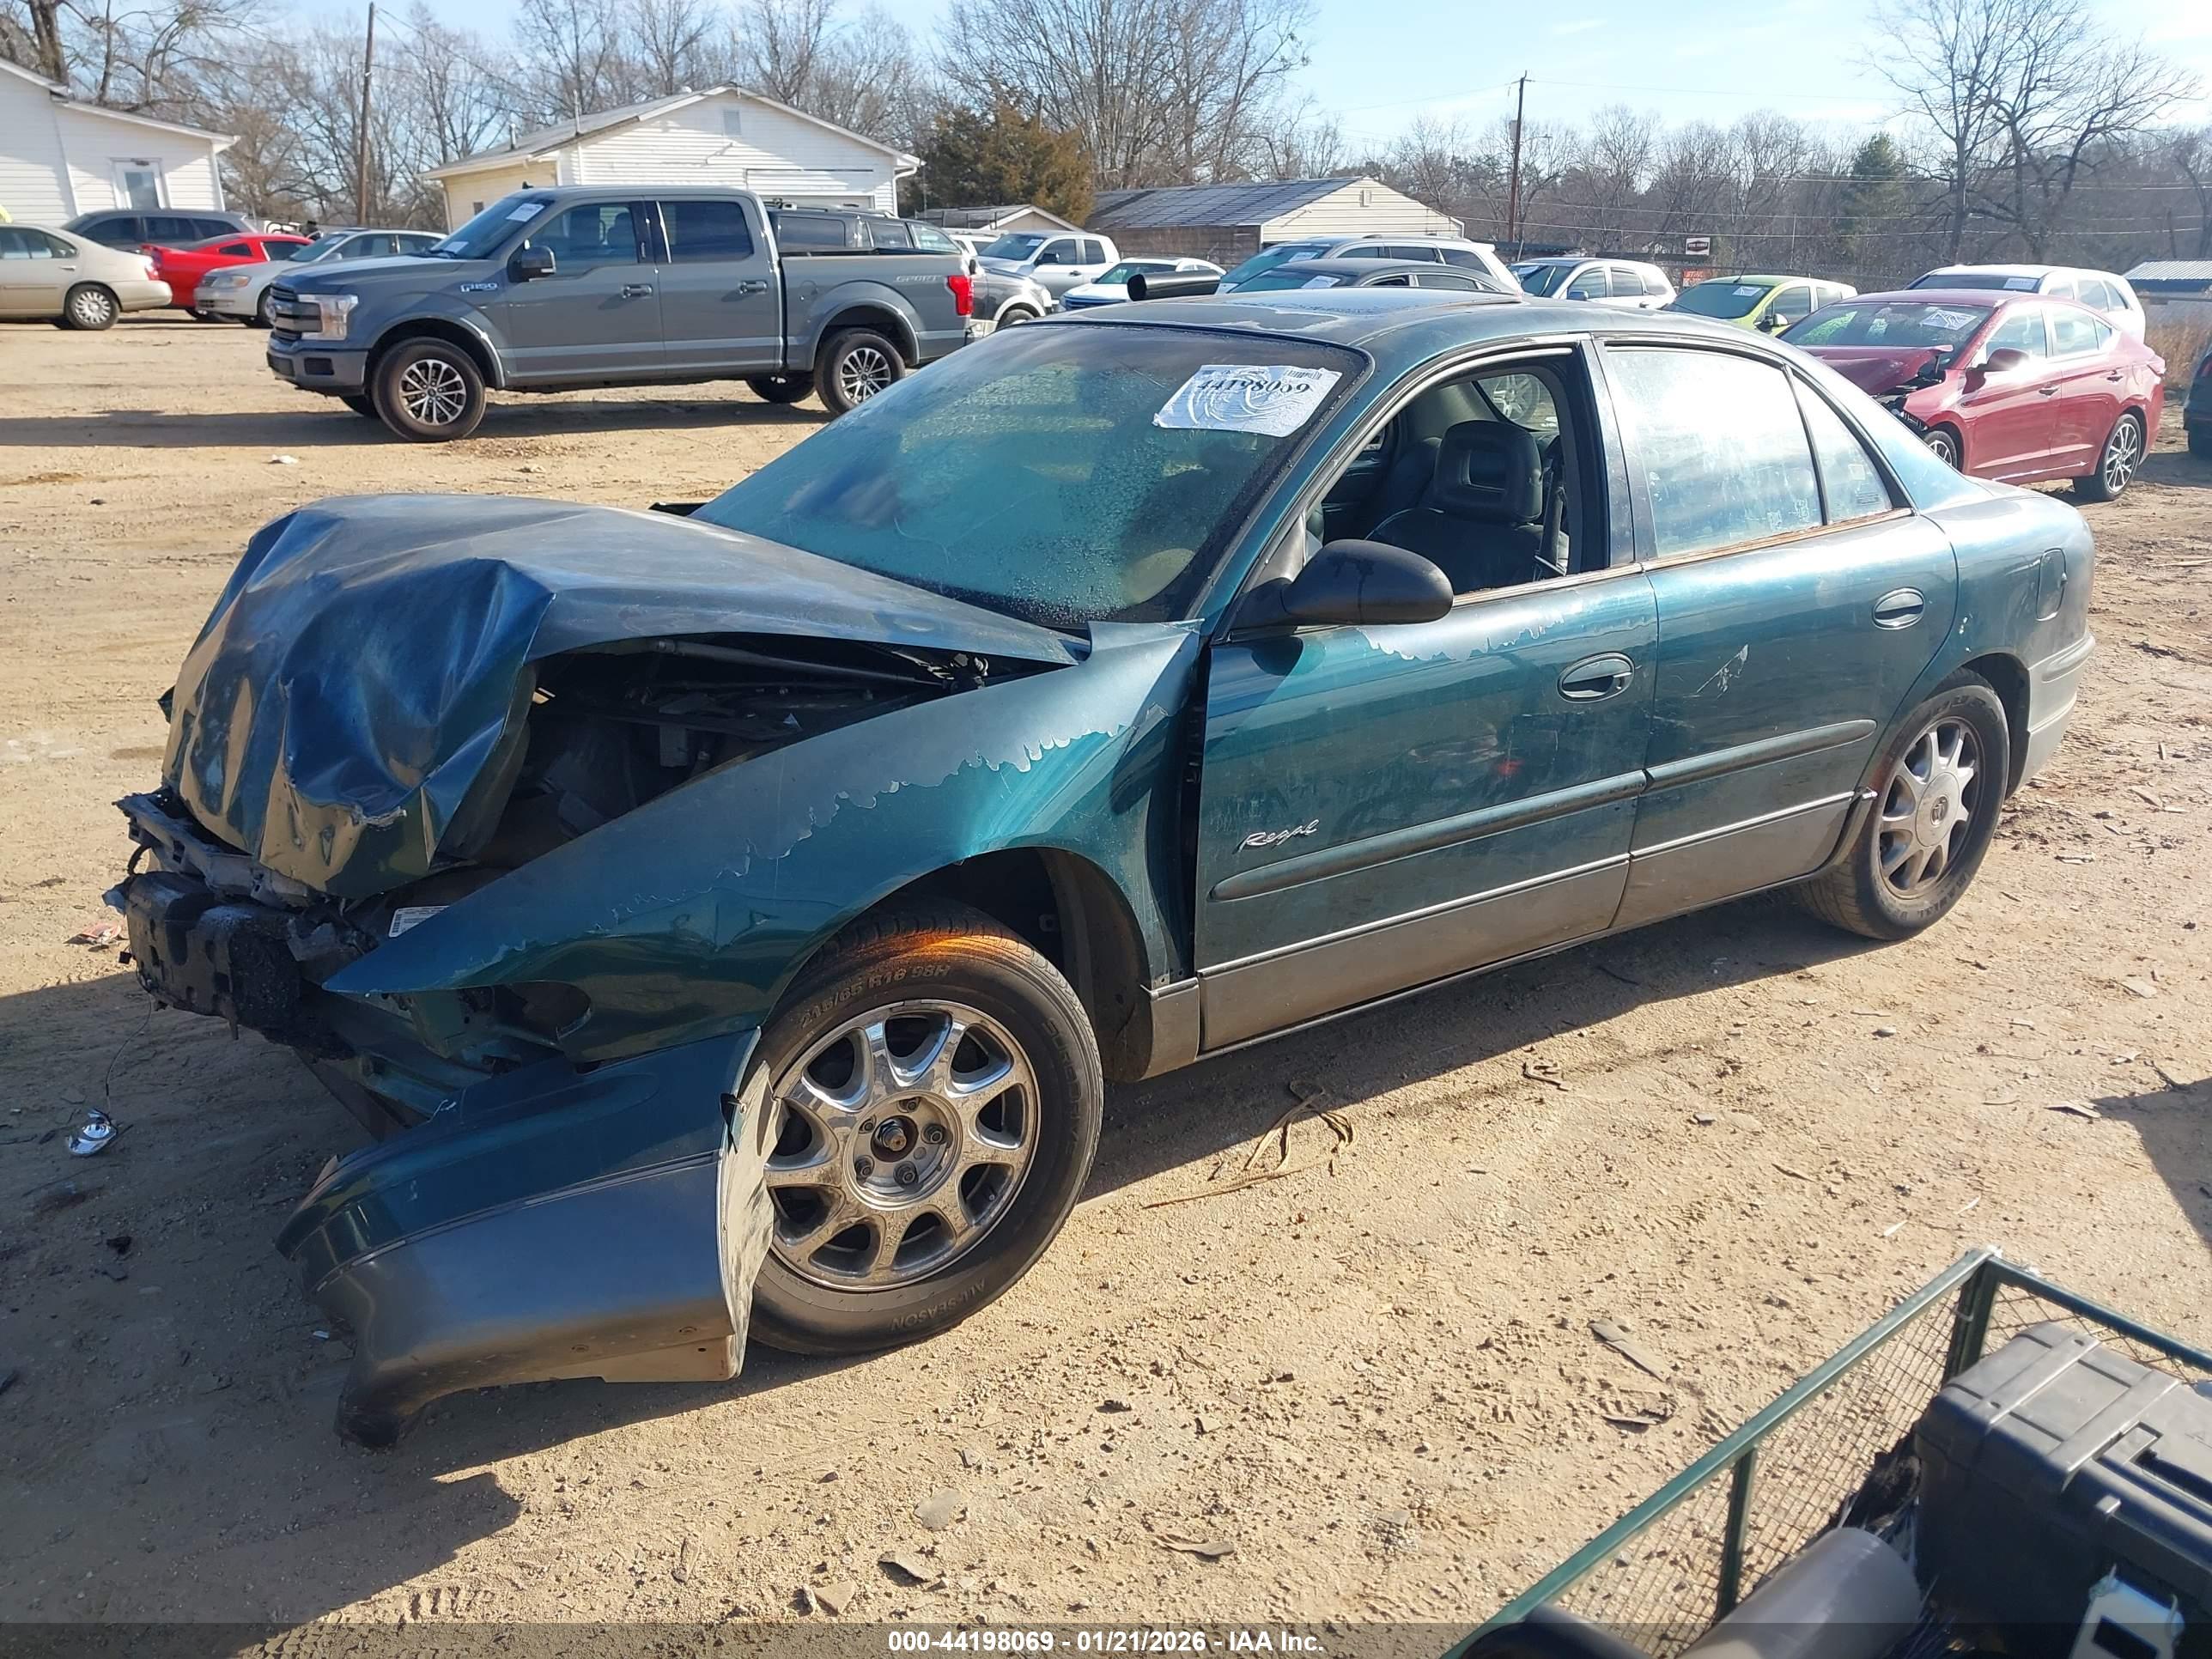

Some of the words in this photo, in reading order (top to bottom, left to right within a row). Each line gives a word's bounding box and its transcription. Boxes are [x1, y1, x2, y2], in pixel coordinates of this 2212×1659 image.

[1237, 818, 1320, 853] Regal
[912, 964, 951, 978] 98H
[891, 1297, 957, 1331] SEASON
